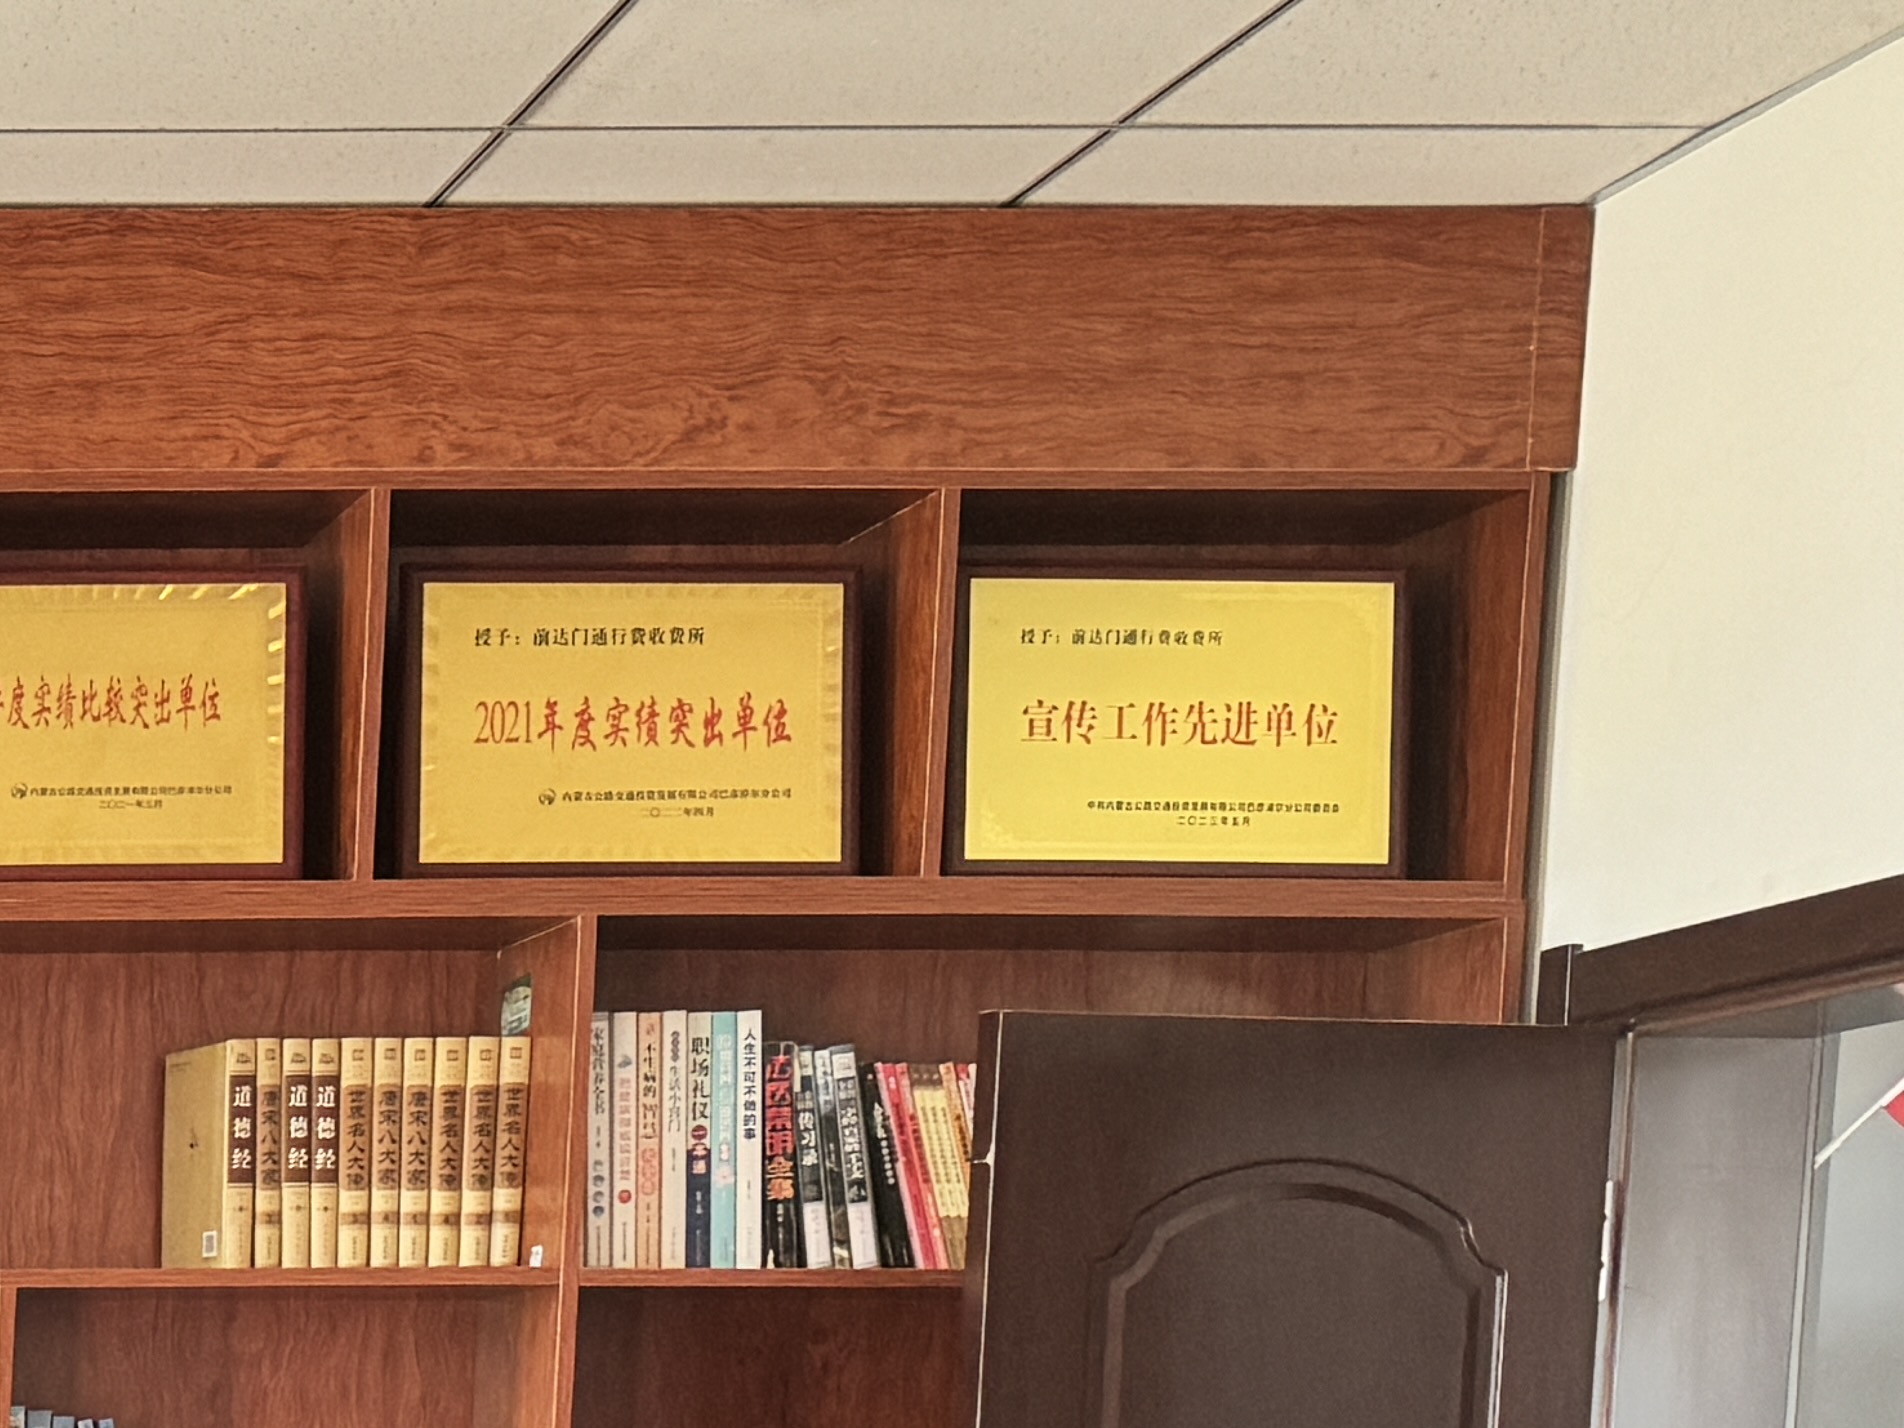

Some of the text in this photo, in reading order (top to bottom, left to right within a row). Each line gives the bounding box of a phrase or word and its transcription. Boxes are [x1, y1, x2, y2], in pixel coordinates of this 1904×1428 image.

[1020, 699, 1339, 747] 宣传工作先进单位
[691, 1036, 710, 1121] 职场礼仪
[232, 1086, 252, 1169] 道德经
[287, 1086, 309, 1169] 道德经
[315, 1086, 337, 1169] 道德经
